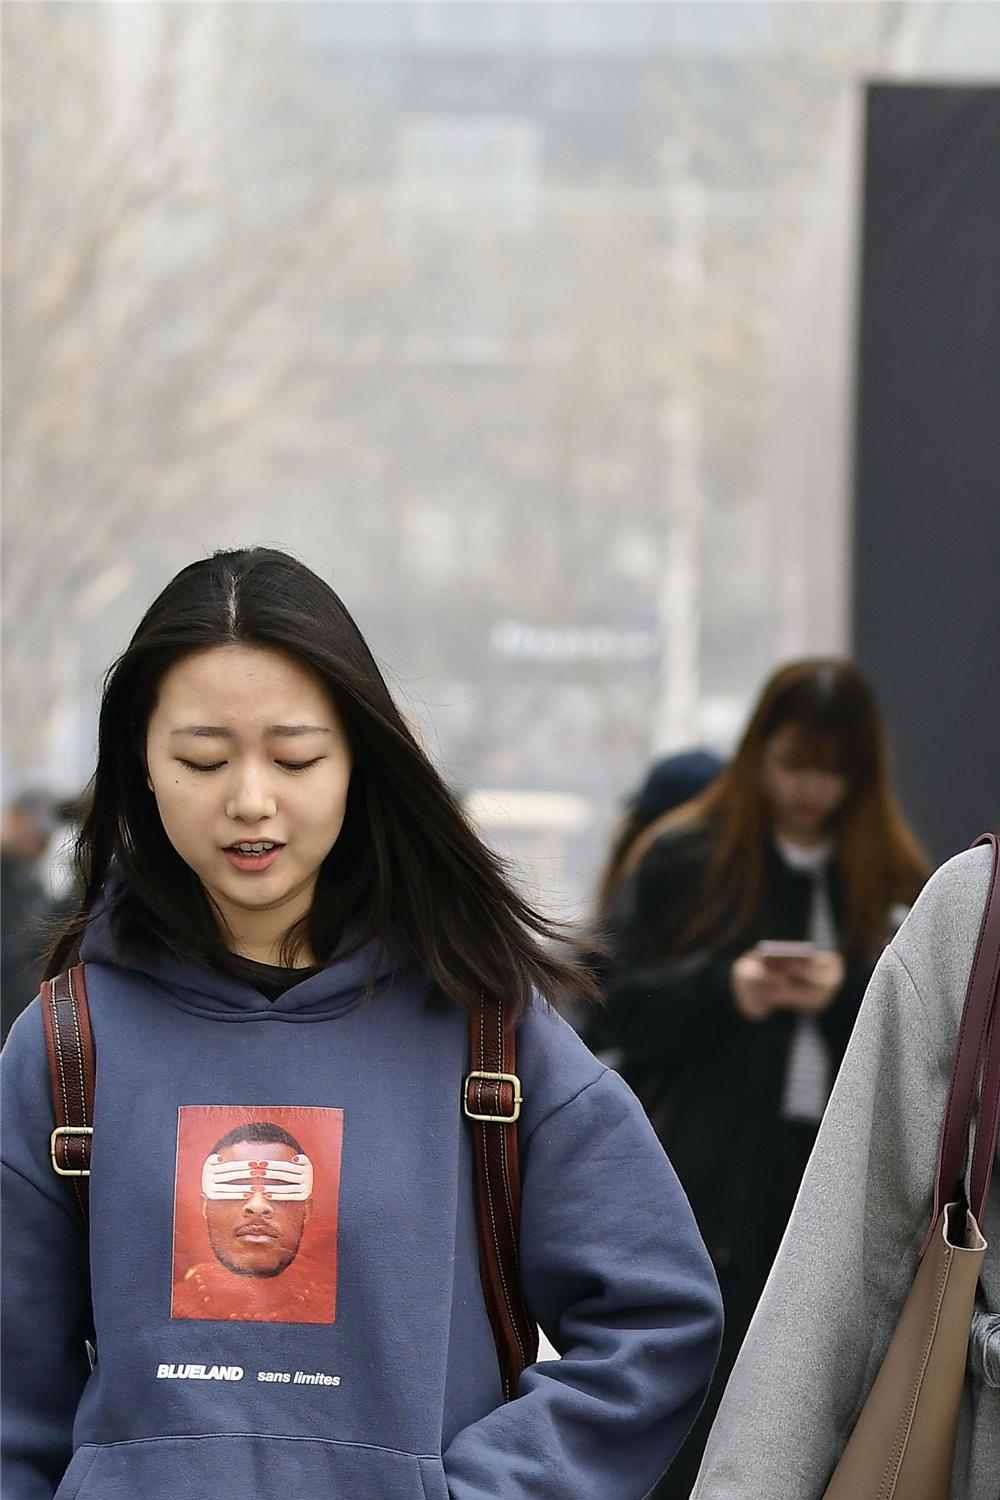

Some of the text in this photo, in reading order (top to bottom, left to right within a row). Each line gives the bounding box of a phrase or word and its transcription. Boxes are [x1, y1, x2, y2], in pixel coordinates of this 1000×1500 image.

[156, 1364, 341, 1386] BLUELAND sans limites
